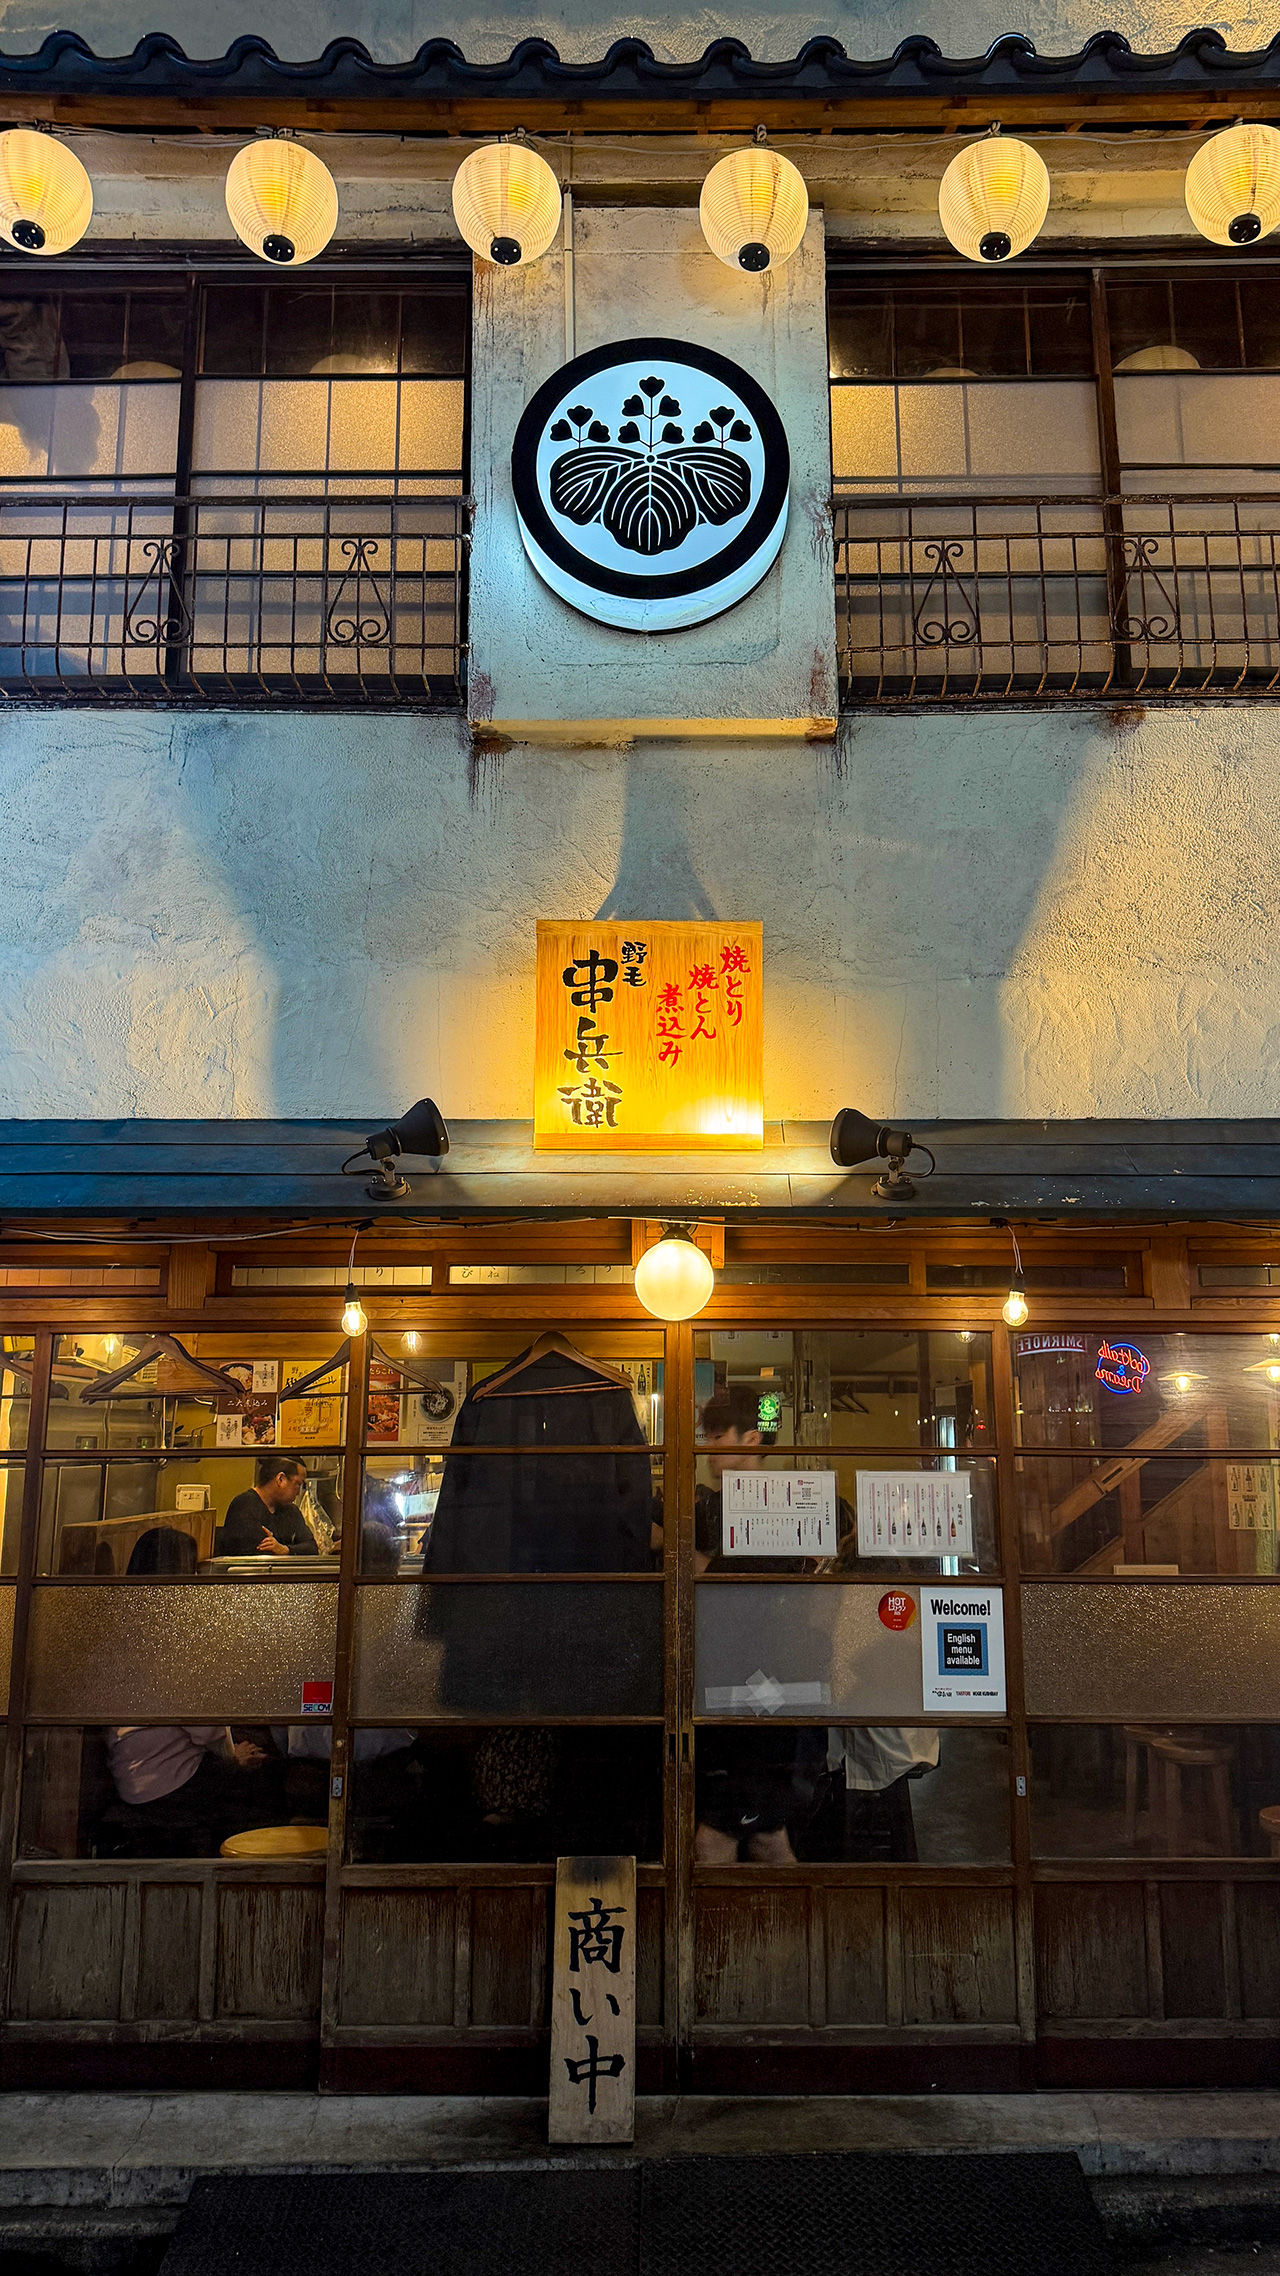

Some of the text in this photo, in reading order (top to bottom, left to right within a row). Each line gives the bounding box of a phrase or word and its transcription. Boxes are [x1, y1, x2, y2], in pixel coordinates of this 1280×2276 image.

[621, 941, 648, 987] 野毛
[687, 963, 720, 1040] 焼とん
[719, 946, 751, 1027] 焼とり
[557, 949, 624, 1128] 串兵衛
[656, 982, 688, 1069] 煮込み
[888, 1597, 906, 1607] HOT
[930, 1599, 991, 1616] Welcome!
[947, 1633, 976, 1645] English
[951, 1646, 973, 1654] menu
[946, 1655, 981, 1665] available
[303, 1703, 331, 1712] SECOM
[564, 1897, 628, 2115] 商い中
